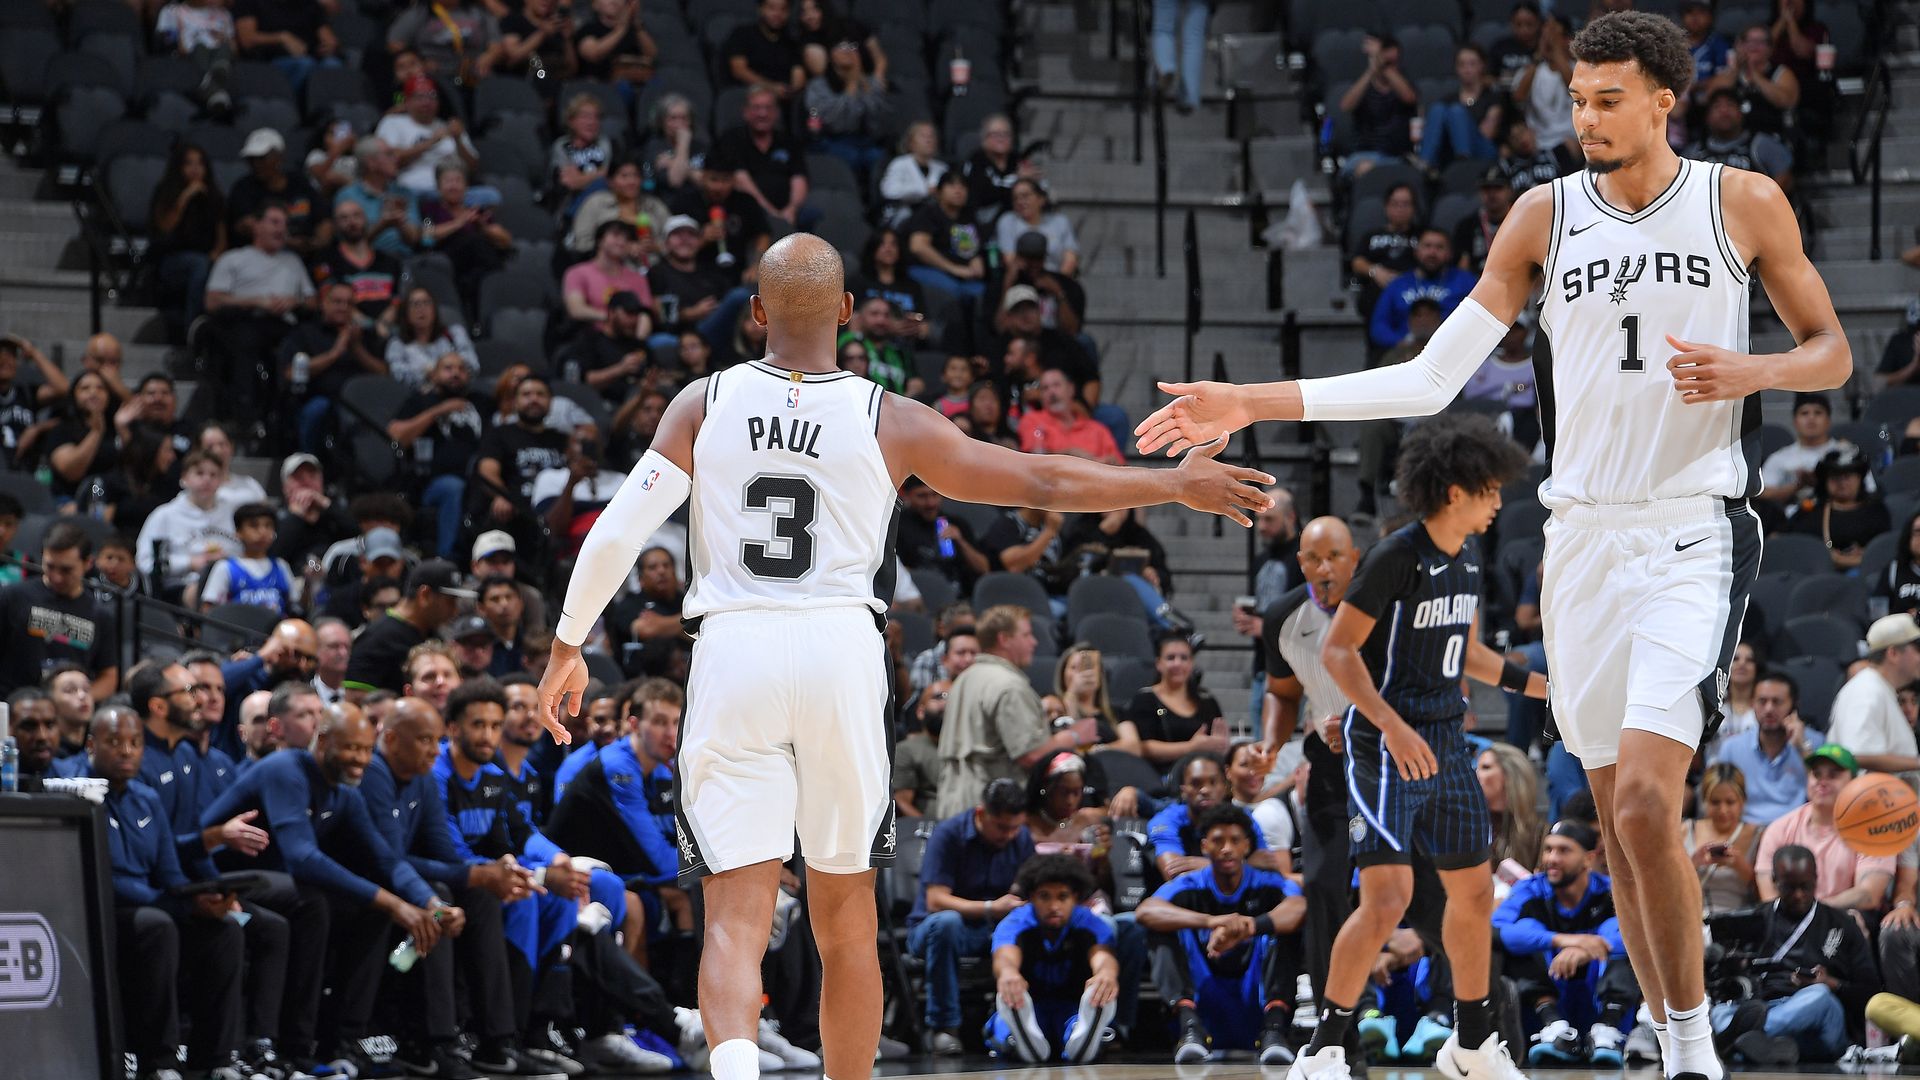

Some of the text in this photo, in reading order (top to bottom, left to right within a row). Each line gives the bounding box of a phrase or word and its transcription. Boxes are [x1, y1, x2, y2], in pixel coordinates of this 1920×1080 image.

[1562, 252, 1711, 304] SPURS
[1618, 313, 1646, 373] 1
[747, 416, 822, 459] PAUL
[738, 472, 820, 584] 3
[1442, 634, 1464, 677] 0
